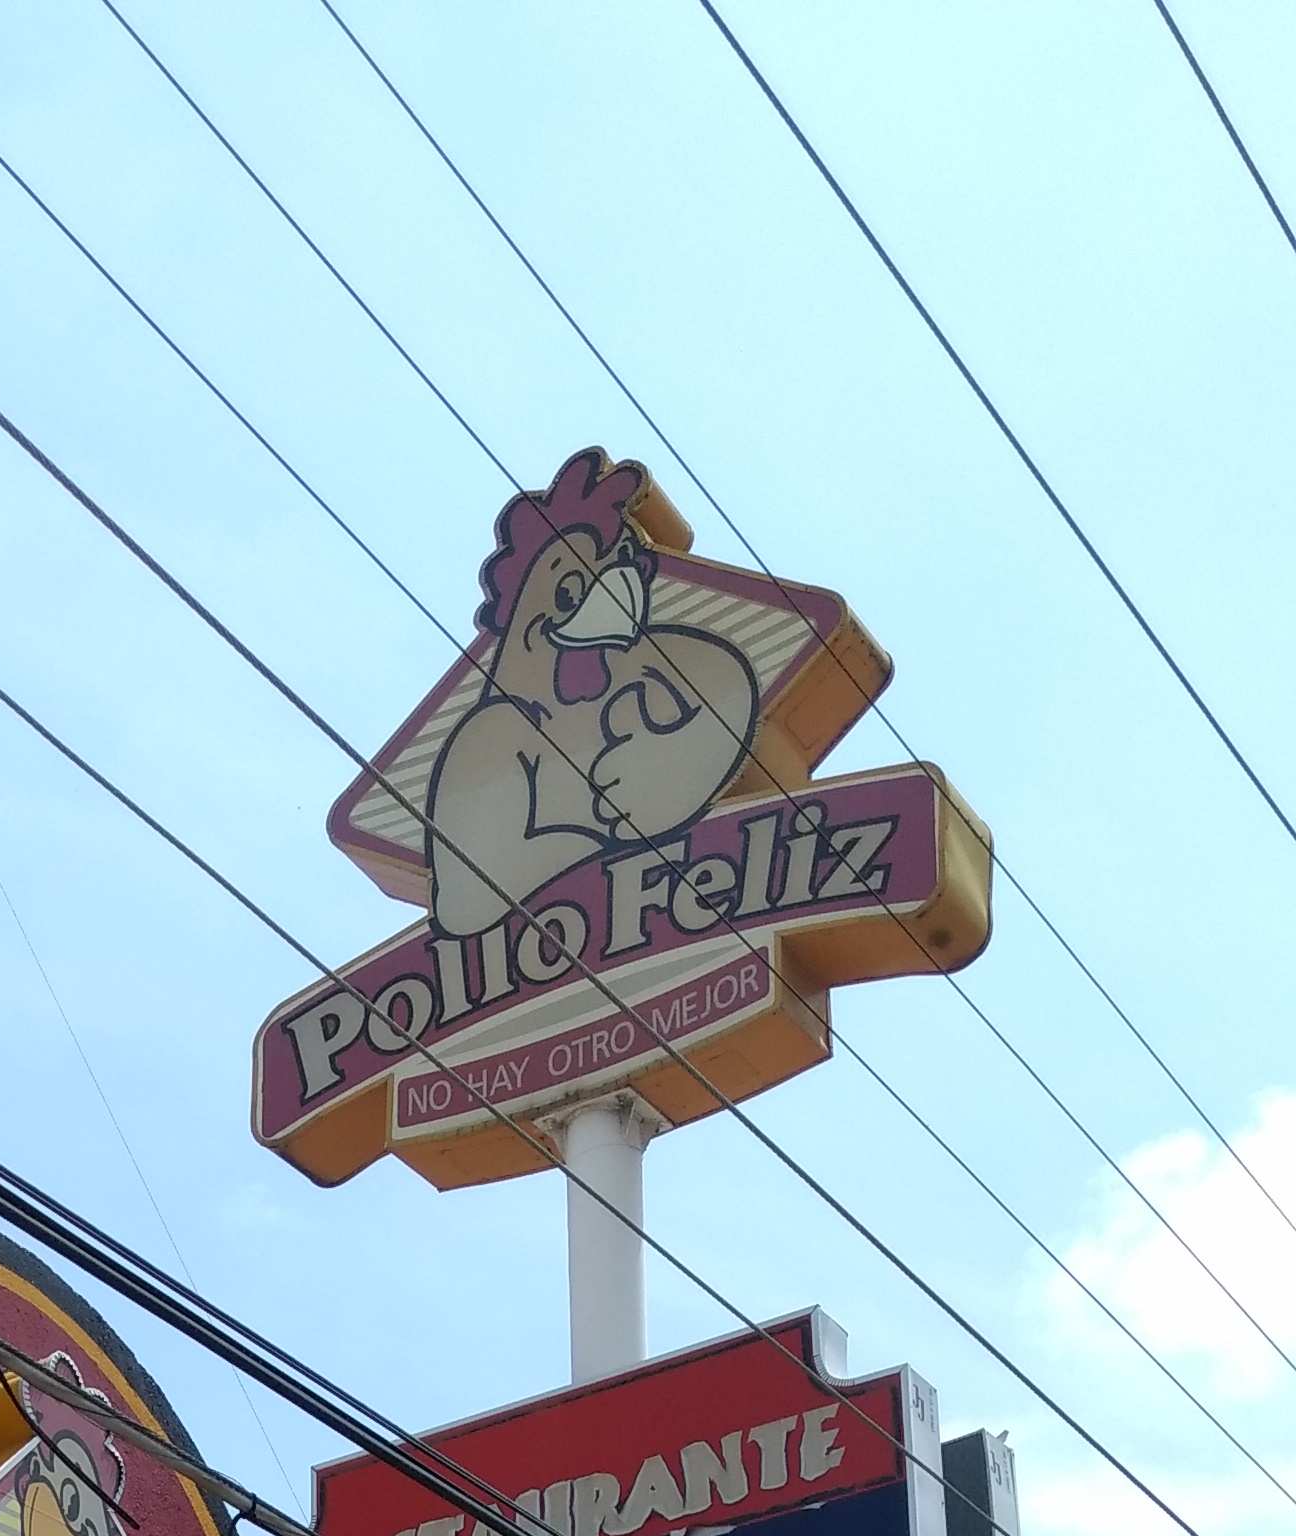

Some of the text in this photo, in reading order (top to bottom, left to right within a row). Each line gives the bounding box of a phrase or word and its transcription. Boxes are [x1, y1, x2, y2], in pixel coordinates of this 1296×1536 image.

[282, 798, 901, 1106] Pollo Feliz
[406, 963, 760, 1117] NO HAY OTRO MEJOR
